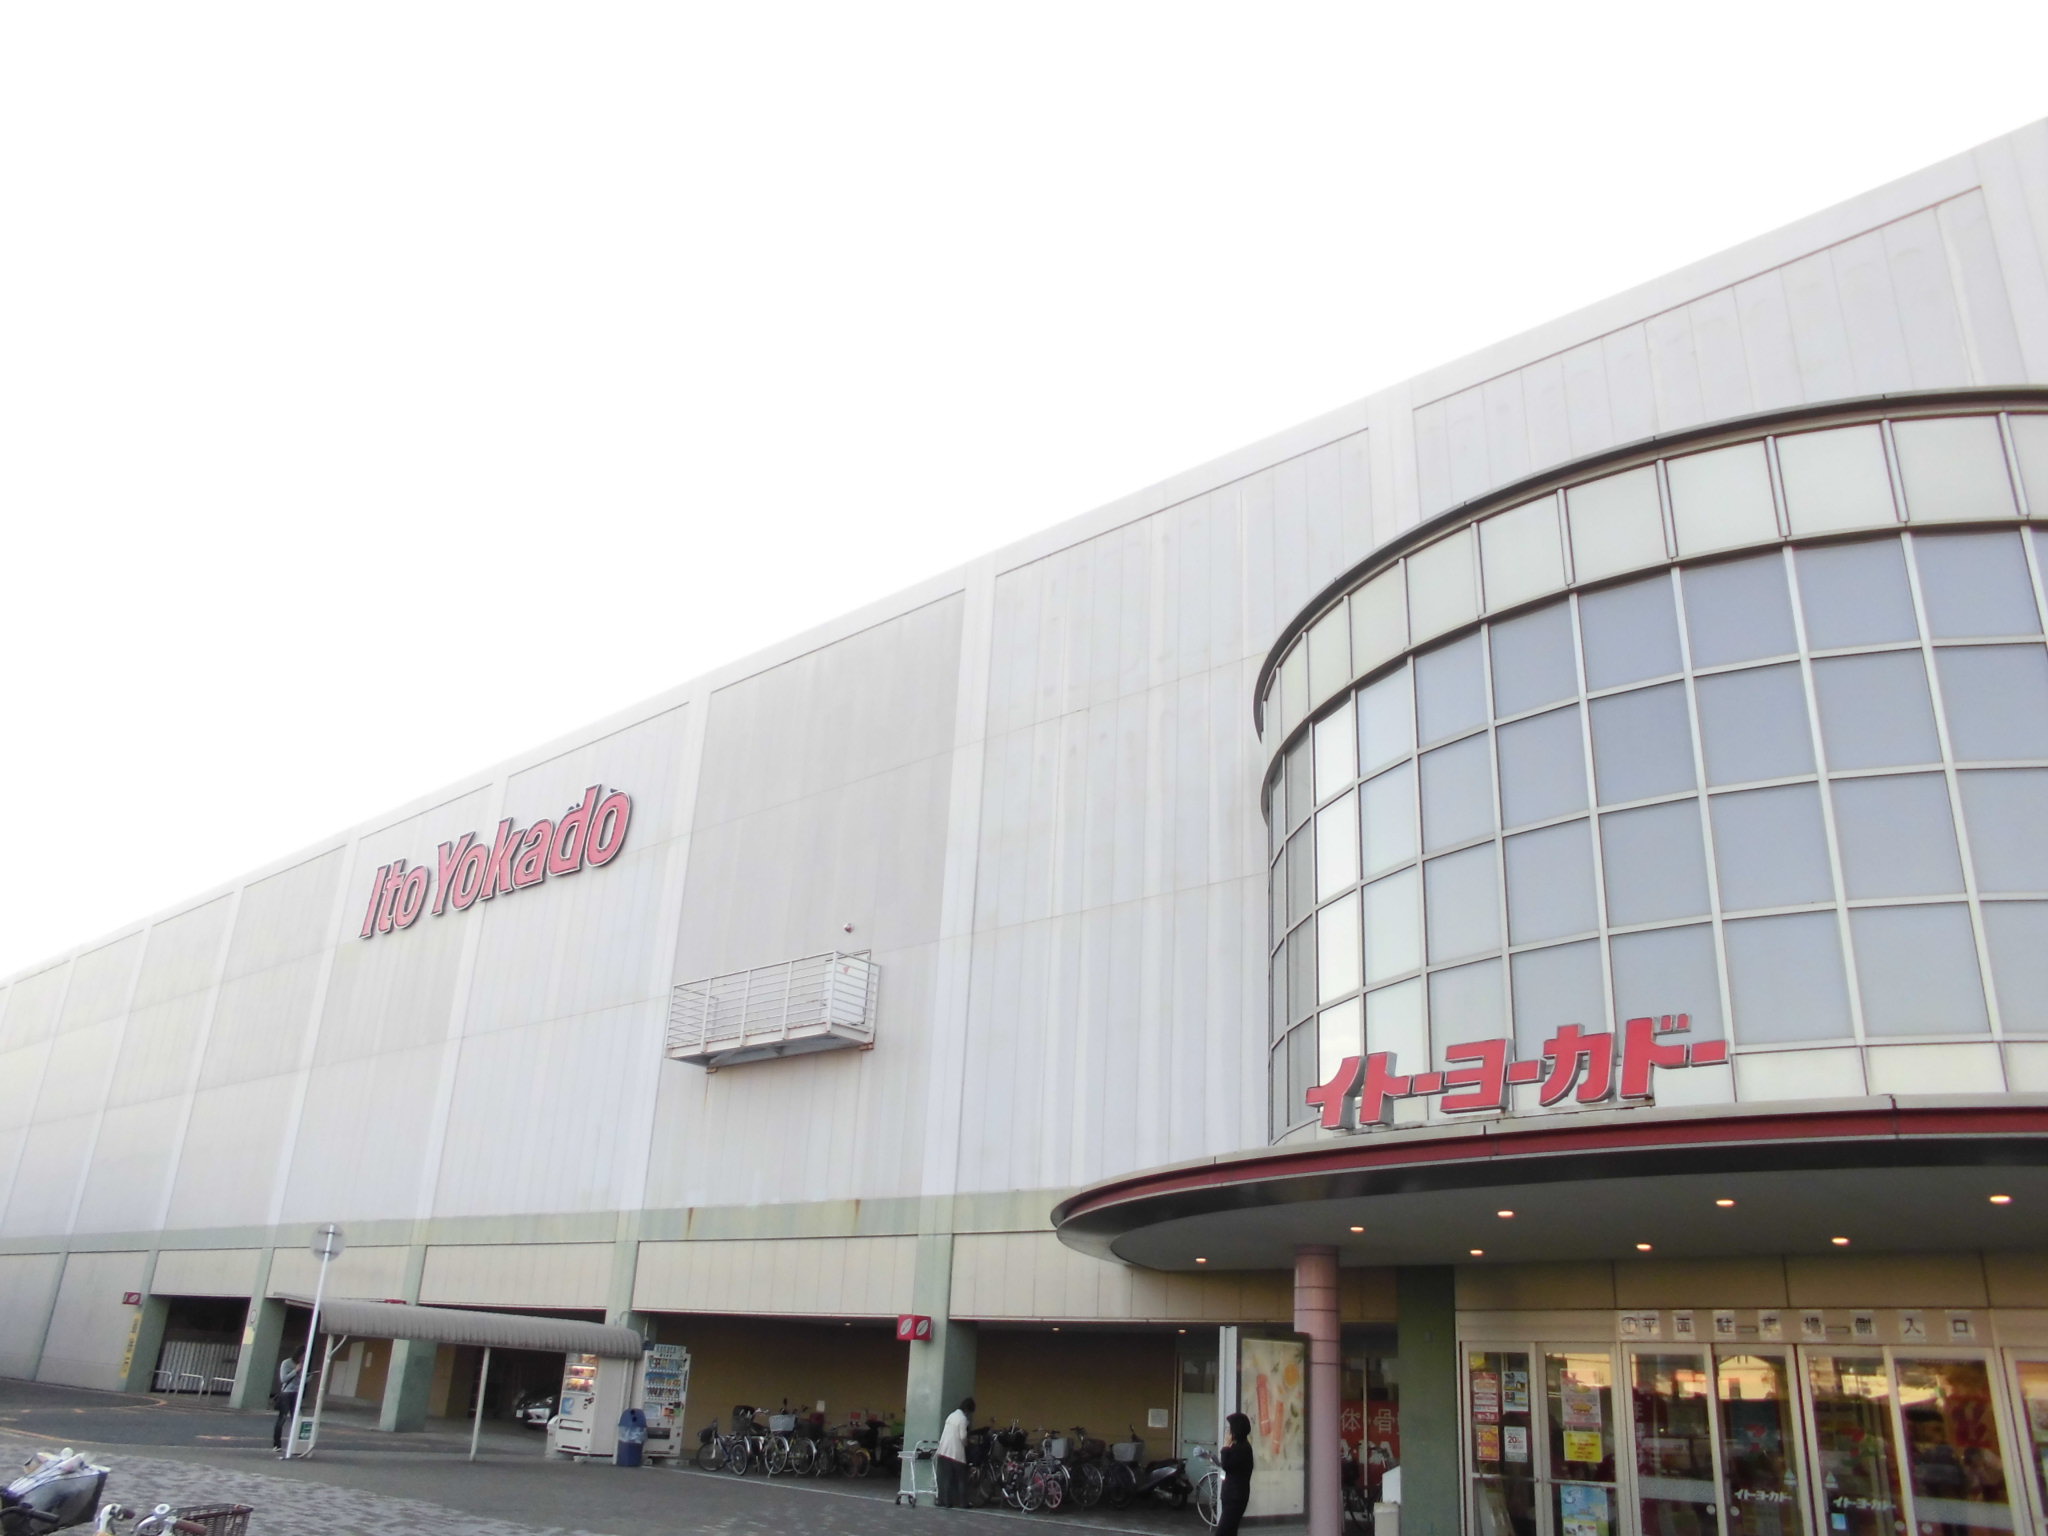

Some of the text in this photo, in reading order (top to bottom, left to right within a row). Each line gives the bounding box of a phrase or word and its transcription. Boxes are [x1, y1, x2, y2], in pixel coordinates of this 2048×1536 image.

[359, 783, 632, 939] Ito Yokado
[1305, 1013, 1730, 1130] イトーヨーカドー
